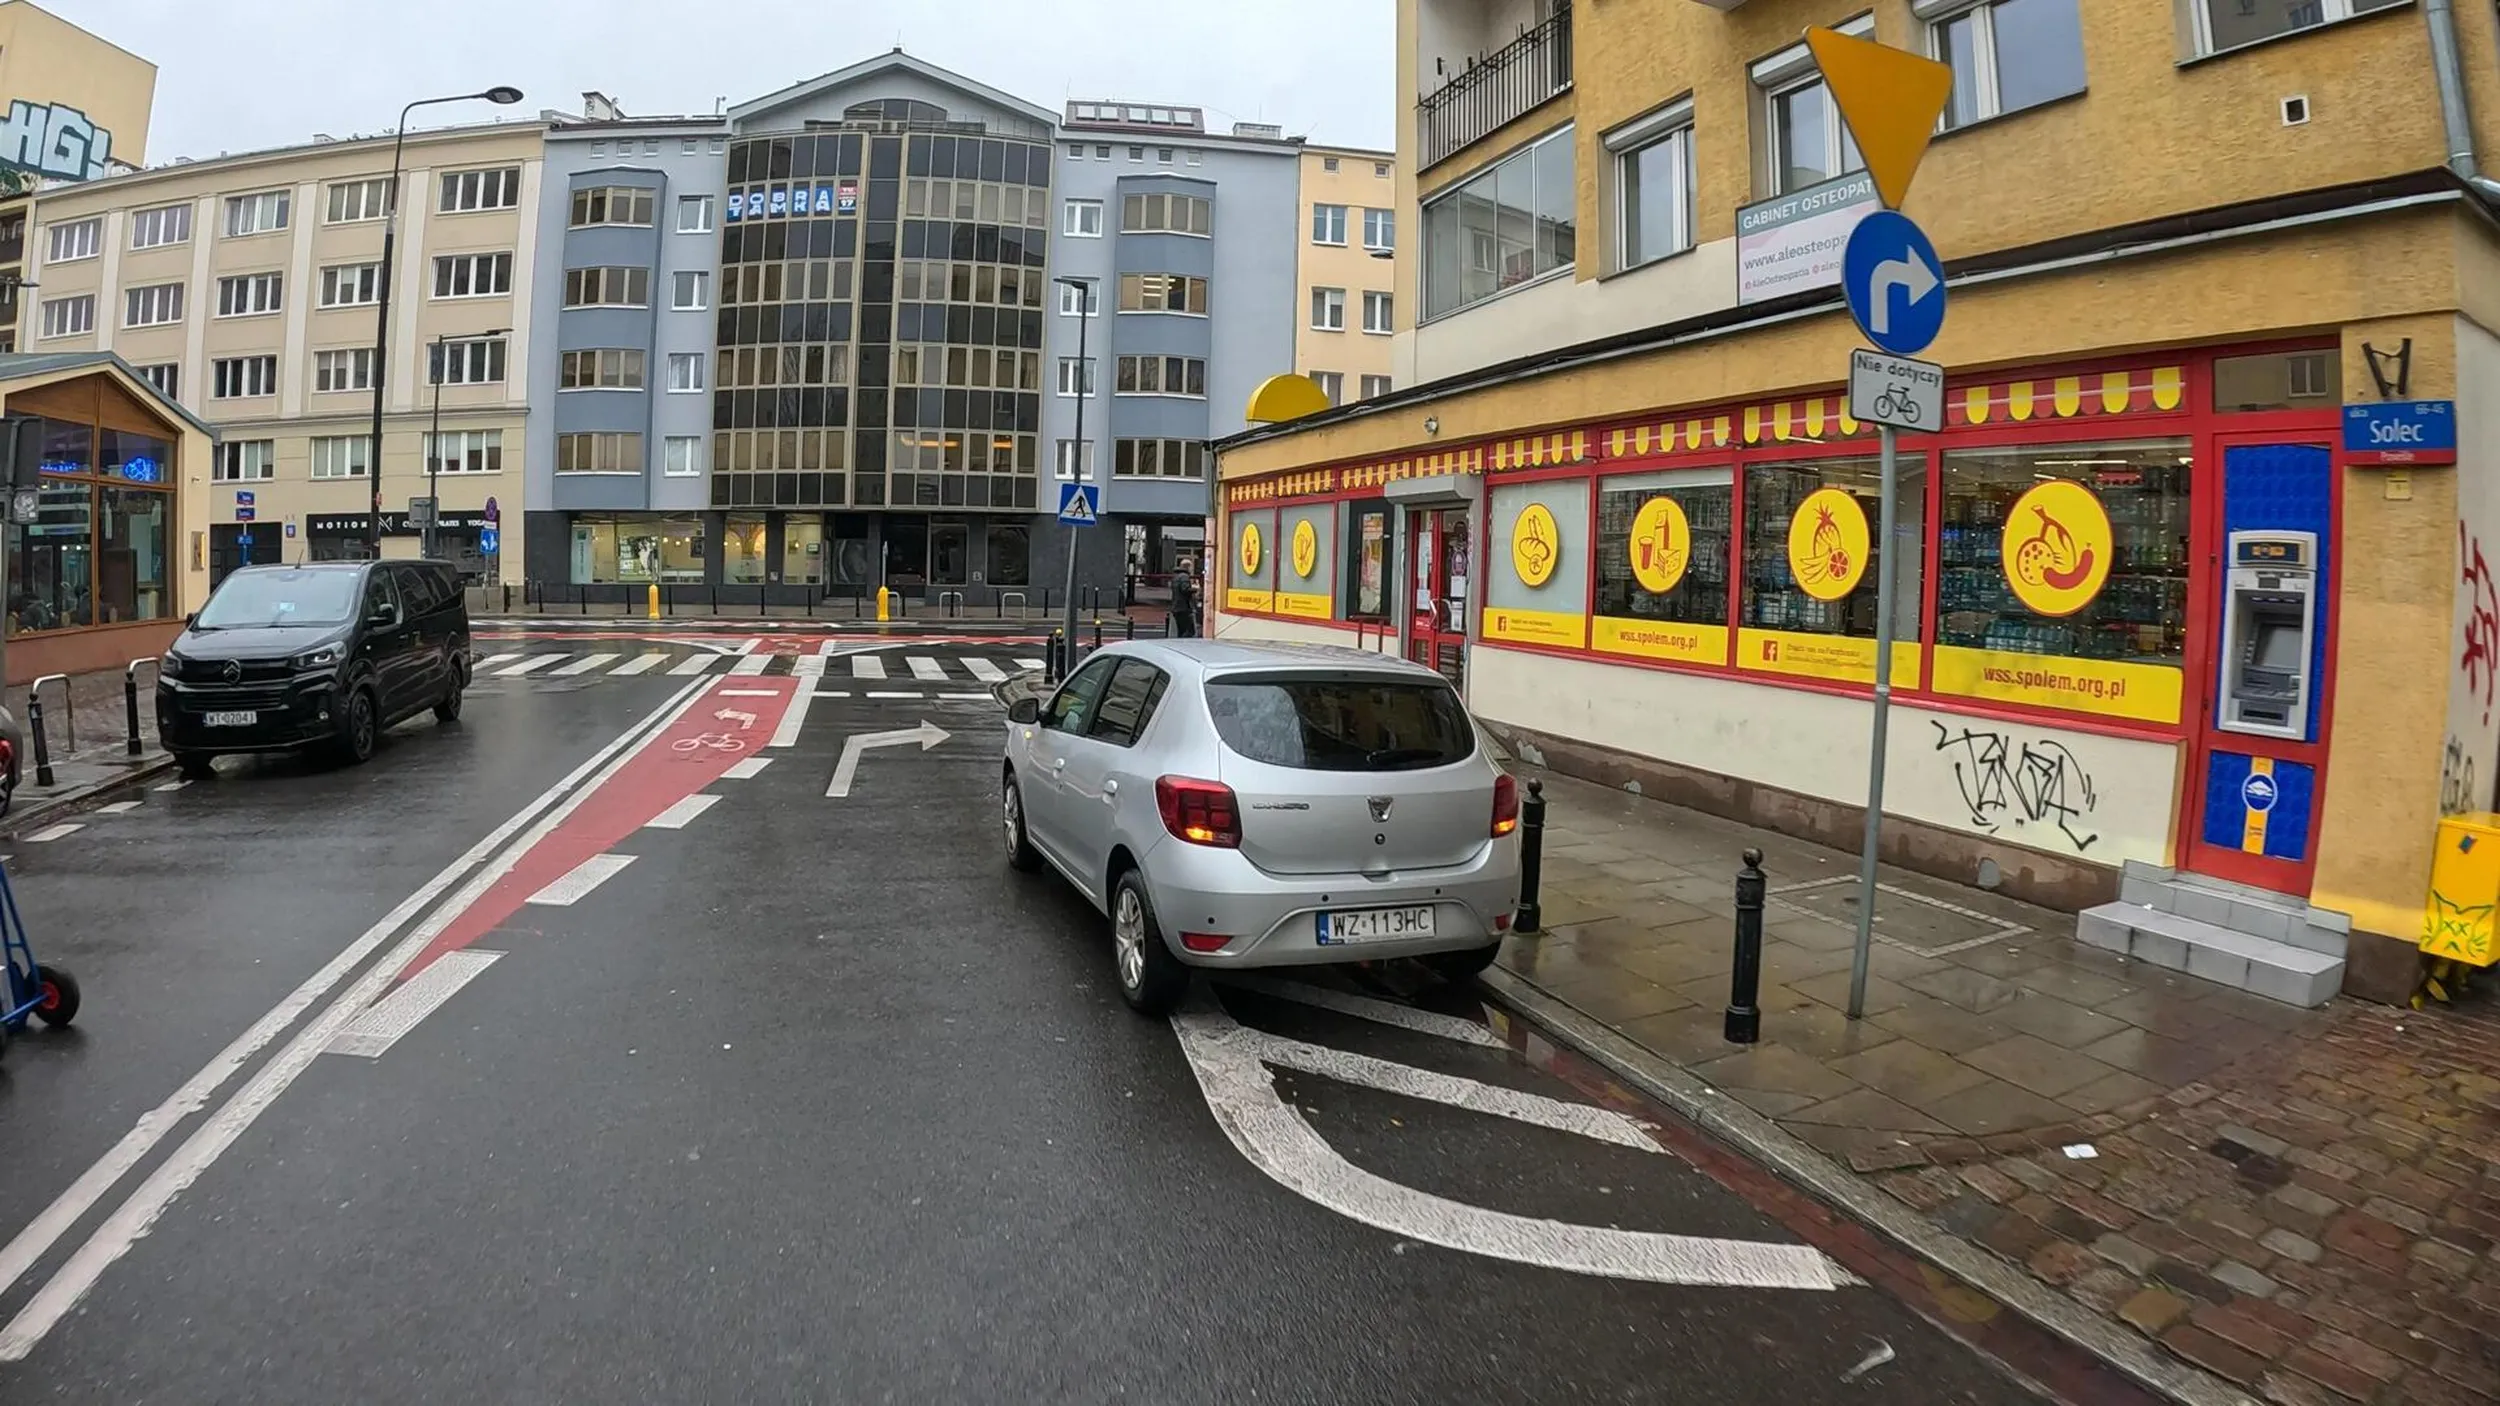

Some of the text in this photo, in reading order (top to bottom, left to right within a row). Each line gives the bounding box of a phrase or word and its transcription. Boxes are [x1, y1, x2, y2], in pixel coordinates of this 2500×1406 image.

[728, 190, 828, 207] DOBRA
[728, 201, 831, 216] TAMKA
[1743, 202, 1798, 229] GABINET
[1857, 354, 1942, 388] Nie dotyczy
[2369, 418, 2424, 443] Solec
[317, 521, 368, 529] MOTION
[1619, 629, 1699, 651] wss.spolem.org.pl
[1983, 667, 2126, 700] wss.spolem.org.pl
[1333, 908, 1428, 937] WZ 113HC
